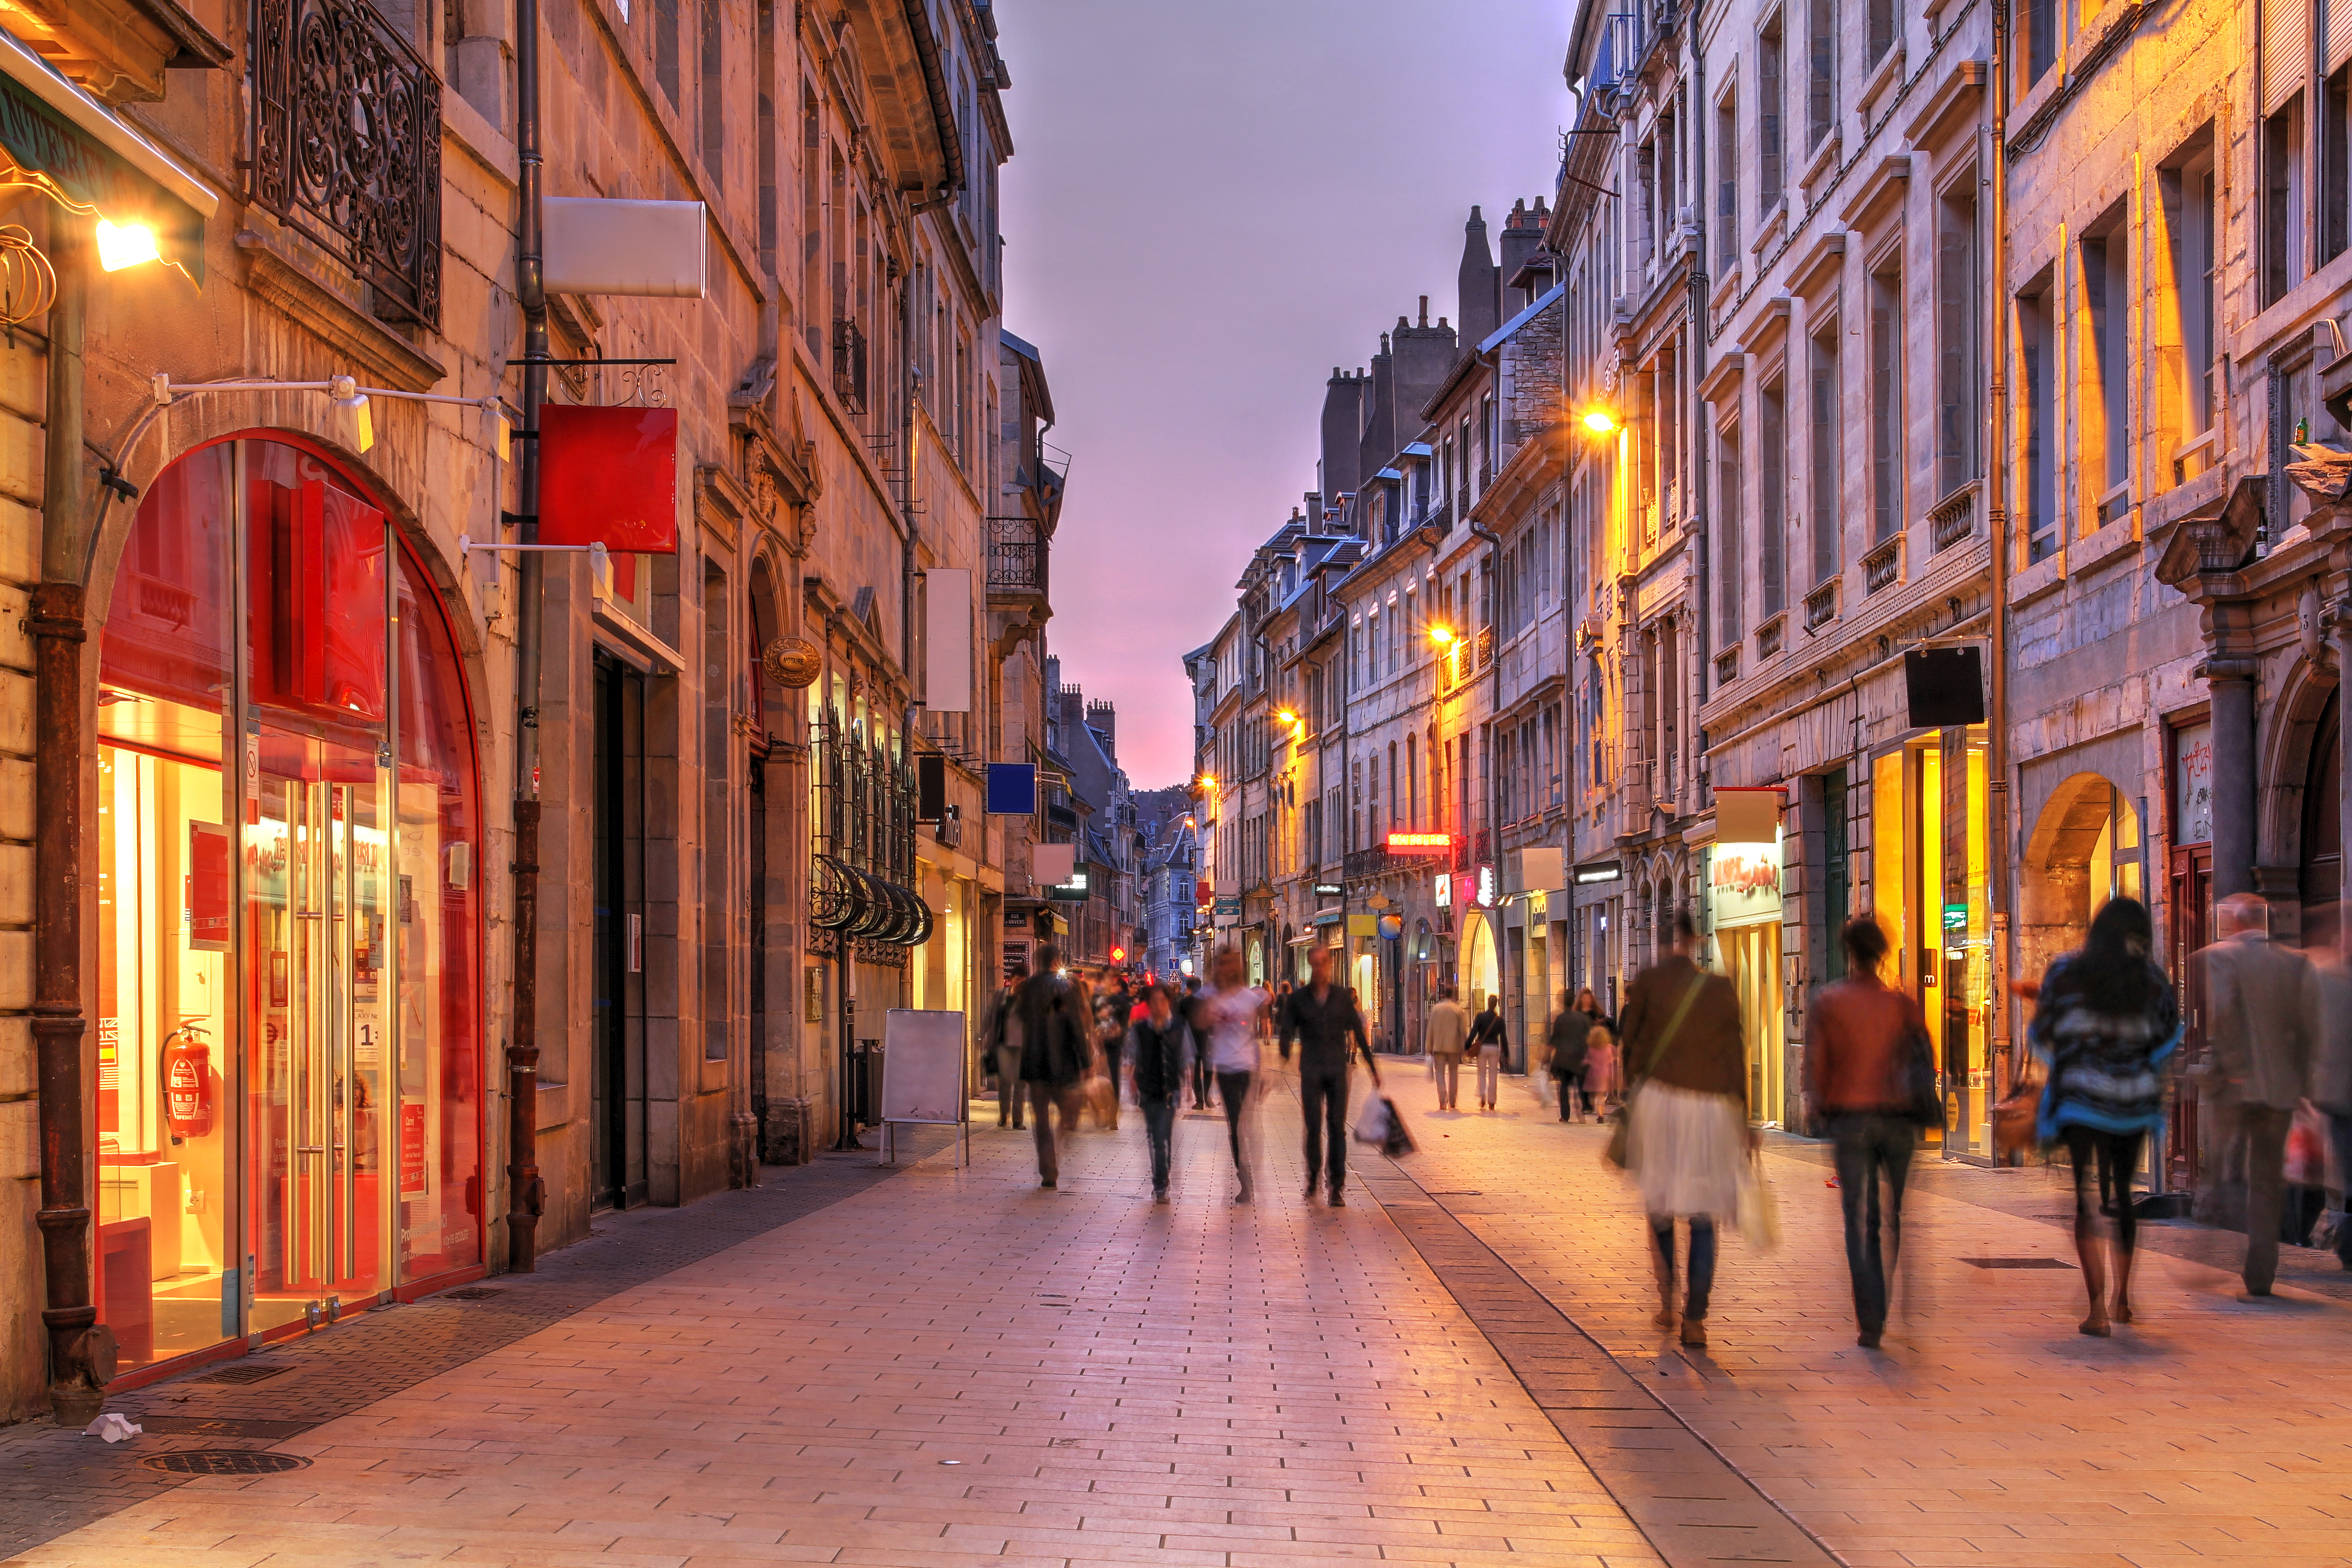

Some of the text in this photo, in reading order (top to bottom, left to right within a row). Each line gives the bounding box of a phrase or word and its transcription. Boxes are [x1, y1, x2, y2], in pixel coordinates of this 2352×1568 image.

[783, 657, 804, 665] NOTAIRE
[1389, 834, 1450, 846] FOURRURES
[1924, 975, 1935, 984] m
